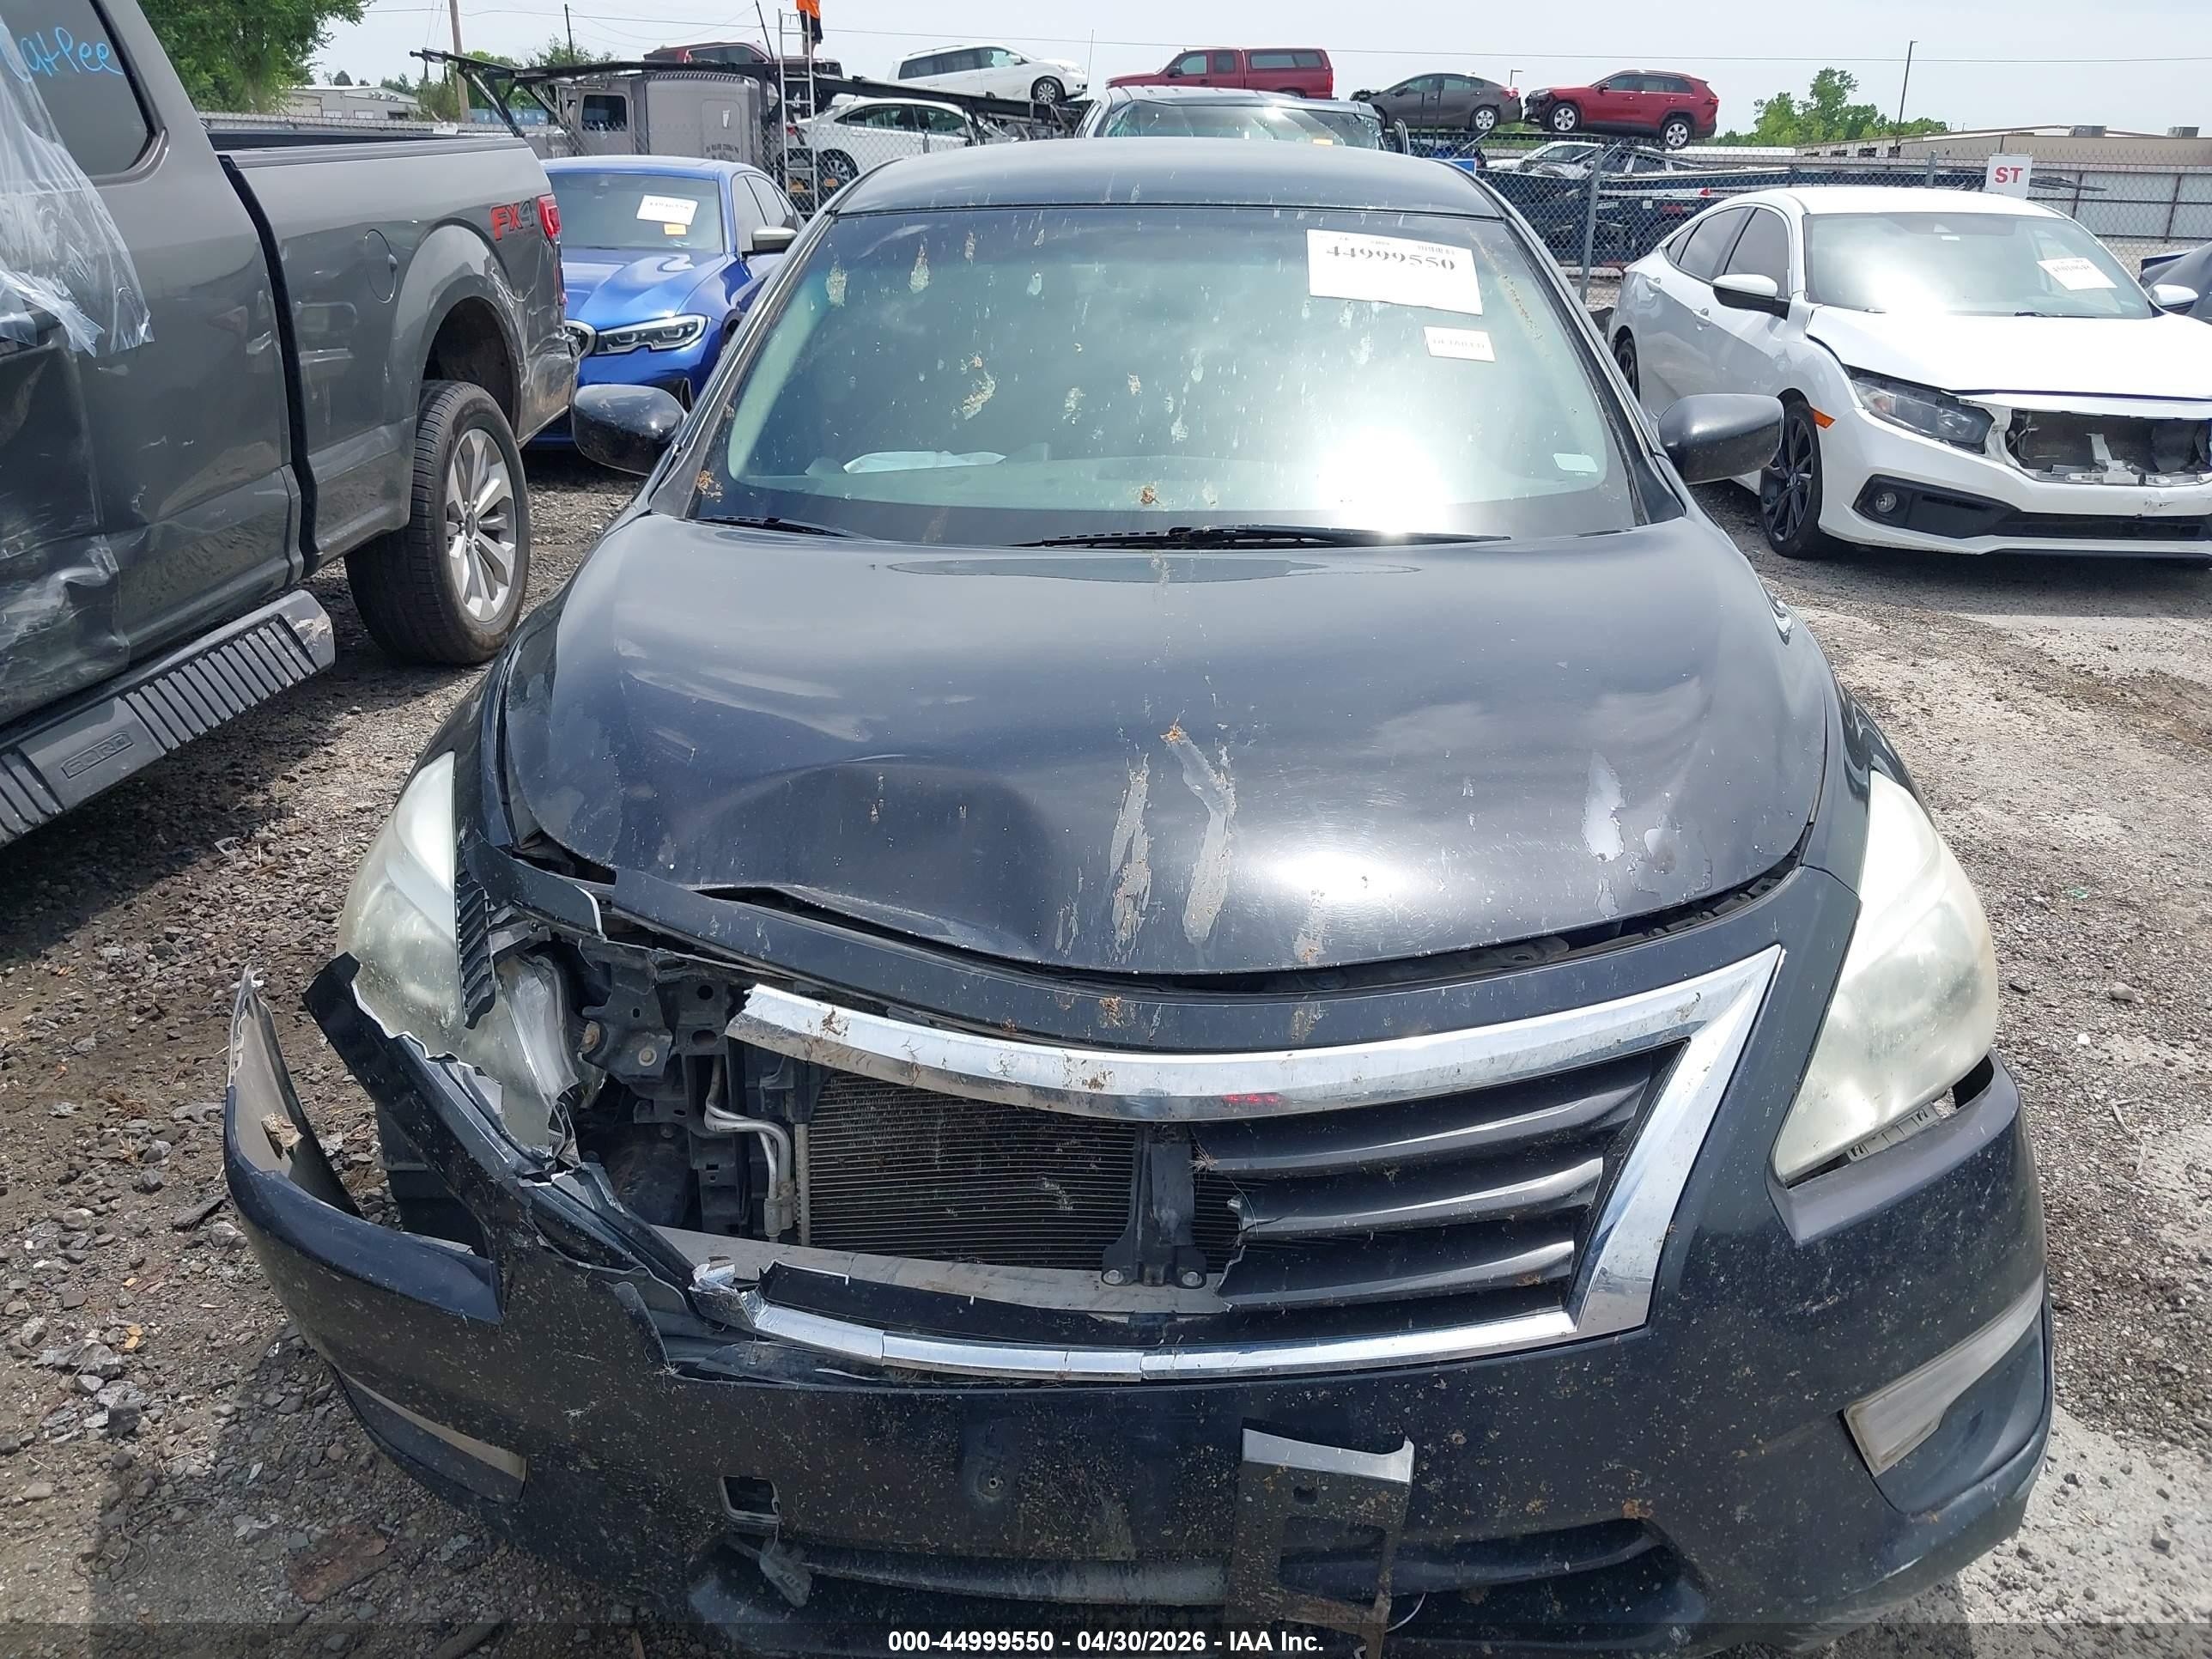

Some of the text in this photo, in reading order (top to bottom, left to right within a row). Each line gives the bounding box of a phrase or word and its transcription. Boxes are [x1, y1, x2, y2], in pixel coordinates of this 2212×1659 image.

[1994, 167, 2023, 184] ST
[490, 200, 535, 241] FX4
[1327, 246, 1455, 270] 44999550
